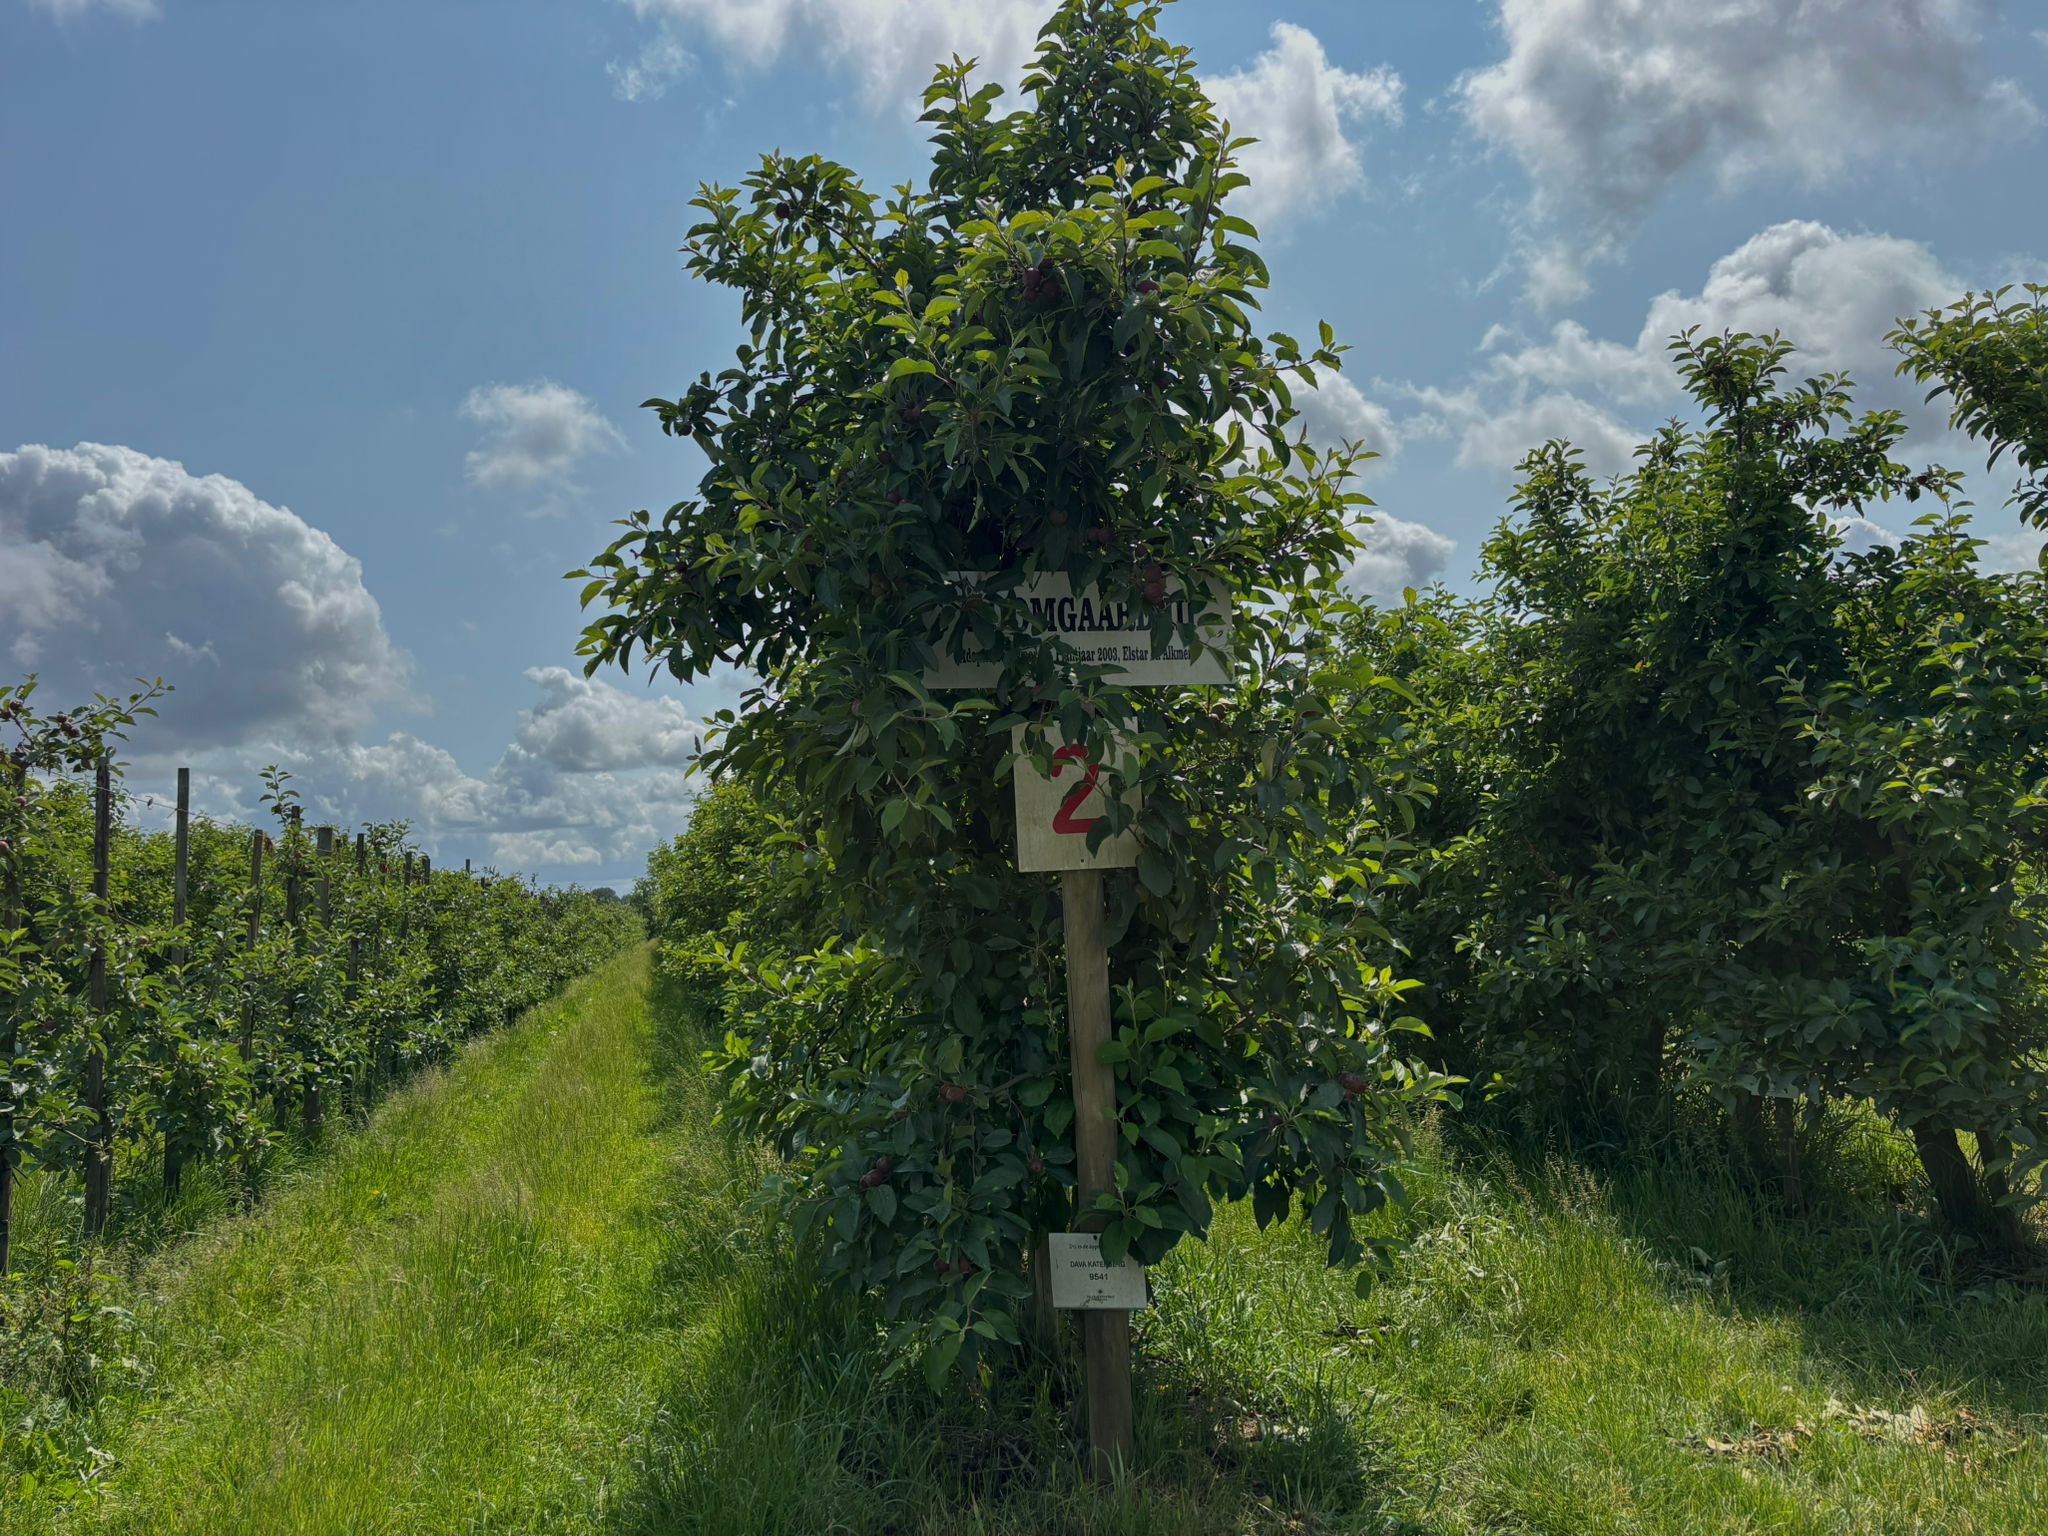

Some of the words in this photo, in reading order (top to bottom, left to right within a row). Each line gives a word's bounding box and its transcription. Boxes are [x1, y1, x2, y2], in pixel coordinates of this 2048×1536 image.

[1097, 645, 1121, 663] 2003,
[1123, 645, 1149, 661] Elstar
[1051, 743, 1101, 834] 2
[1070, 1260, 1087, 1268] DAVA
